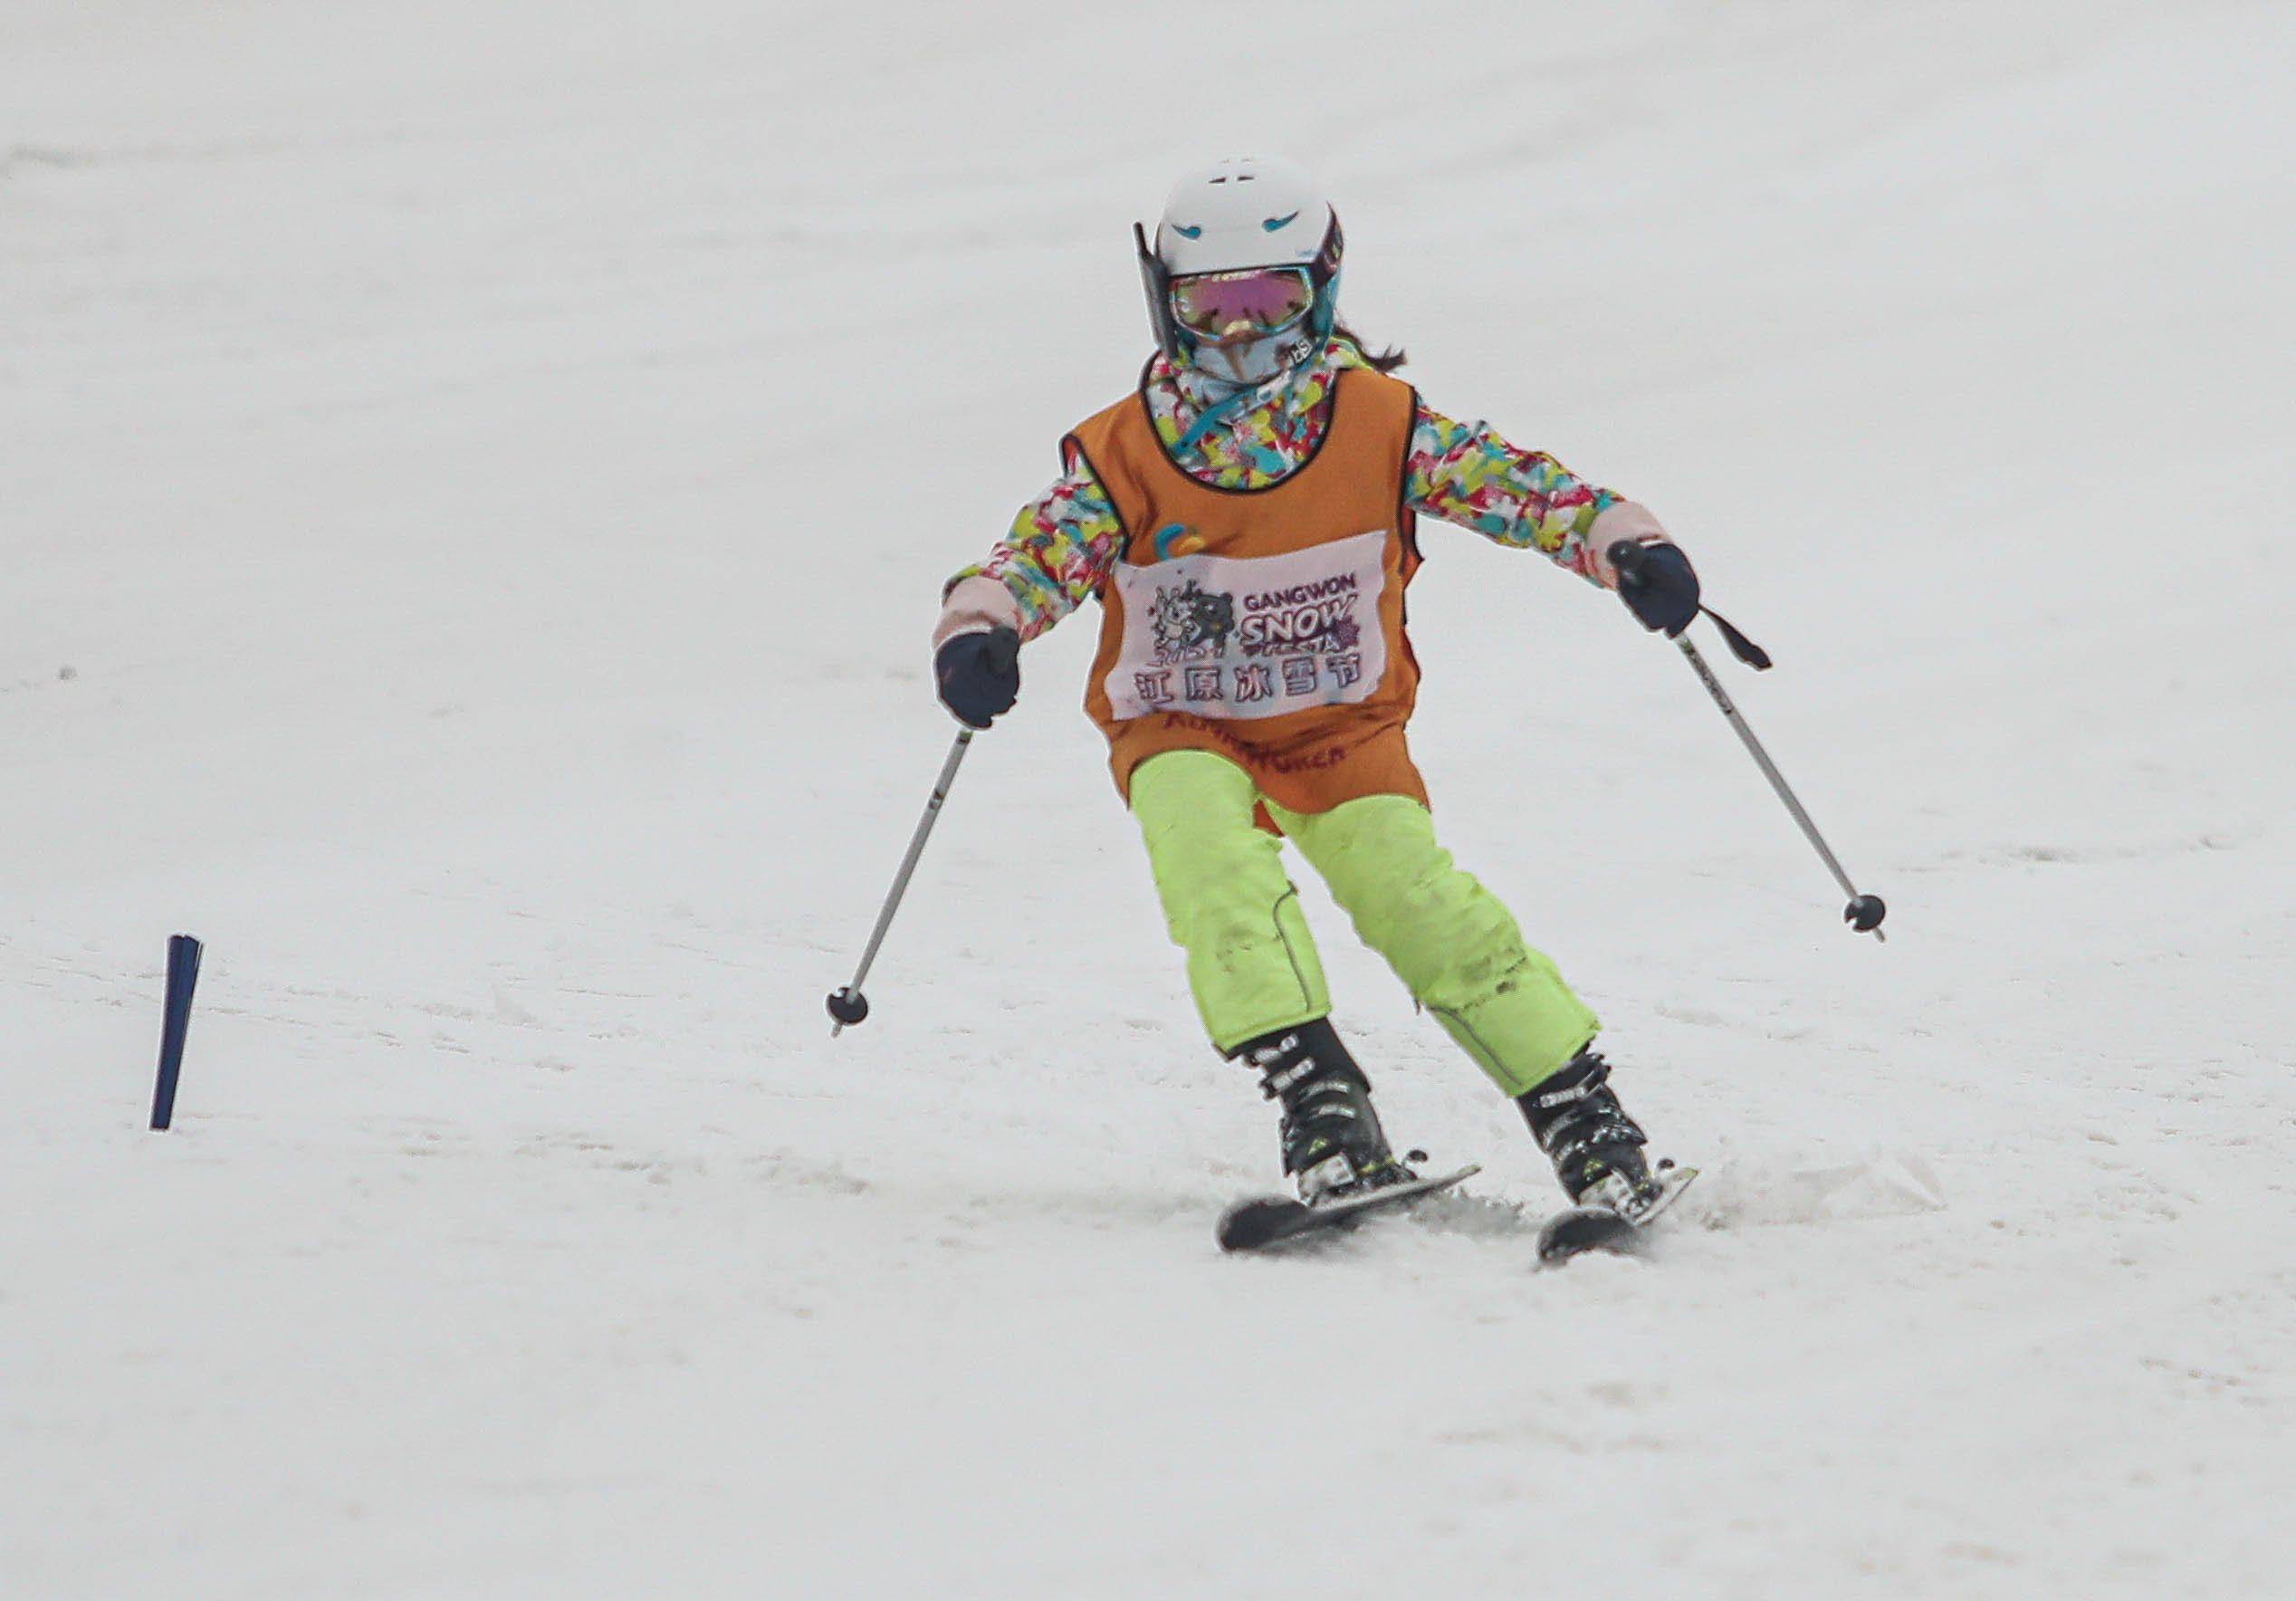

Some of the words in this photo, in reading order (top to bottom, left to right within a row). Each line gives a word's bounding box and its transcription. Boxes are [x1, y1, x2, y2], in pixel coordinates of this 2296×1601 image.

[1244, 572, 1356, 611] GANGWON
[1240, 592, 1359, 647] SNOW
[1134, 652, 1362, 704] 江原冰雪节
